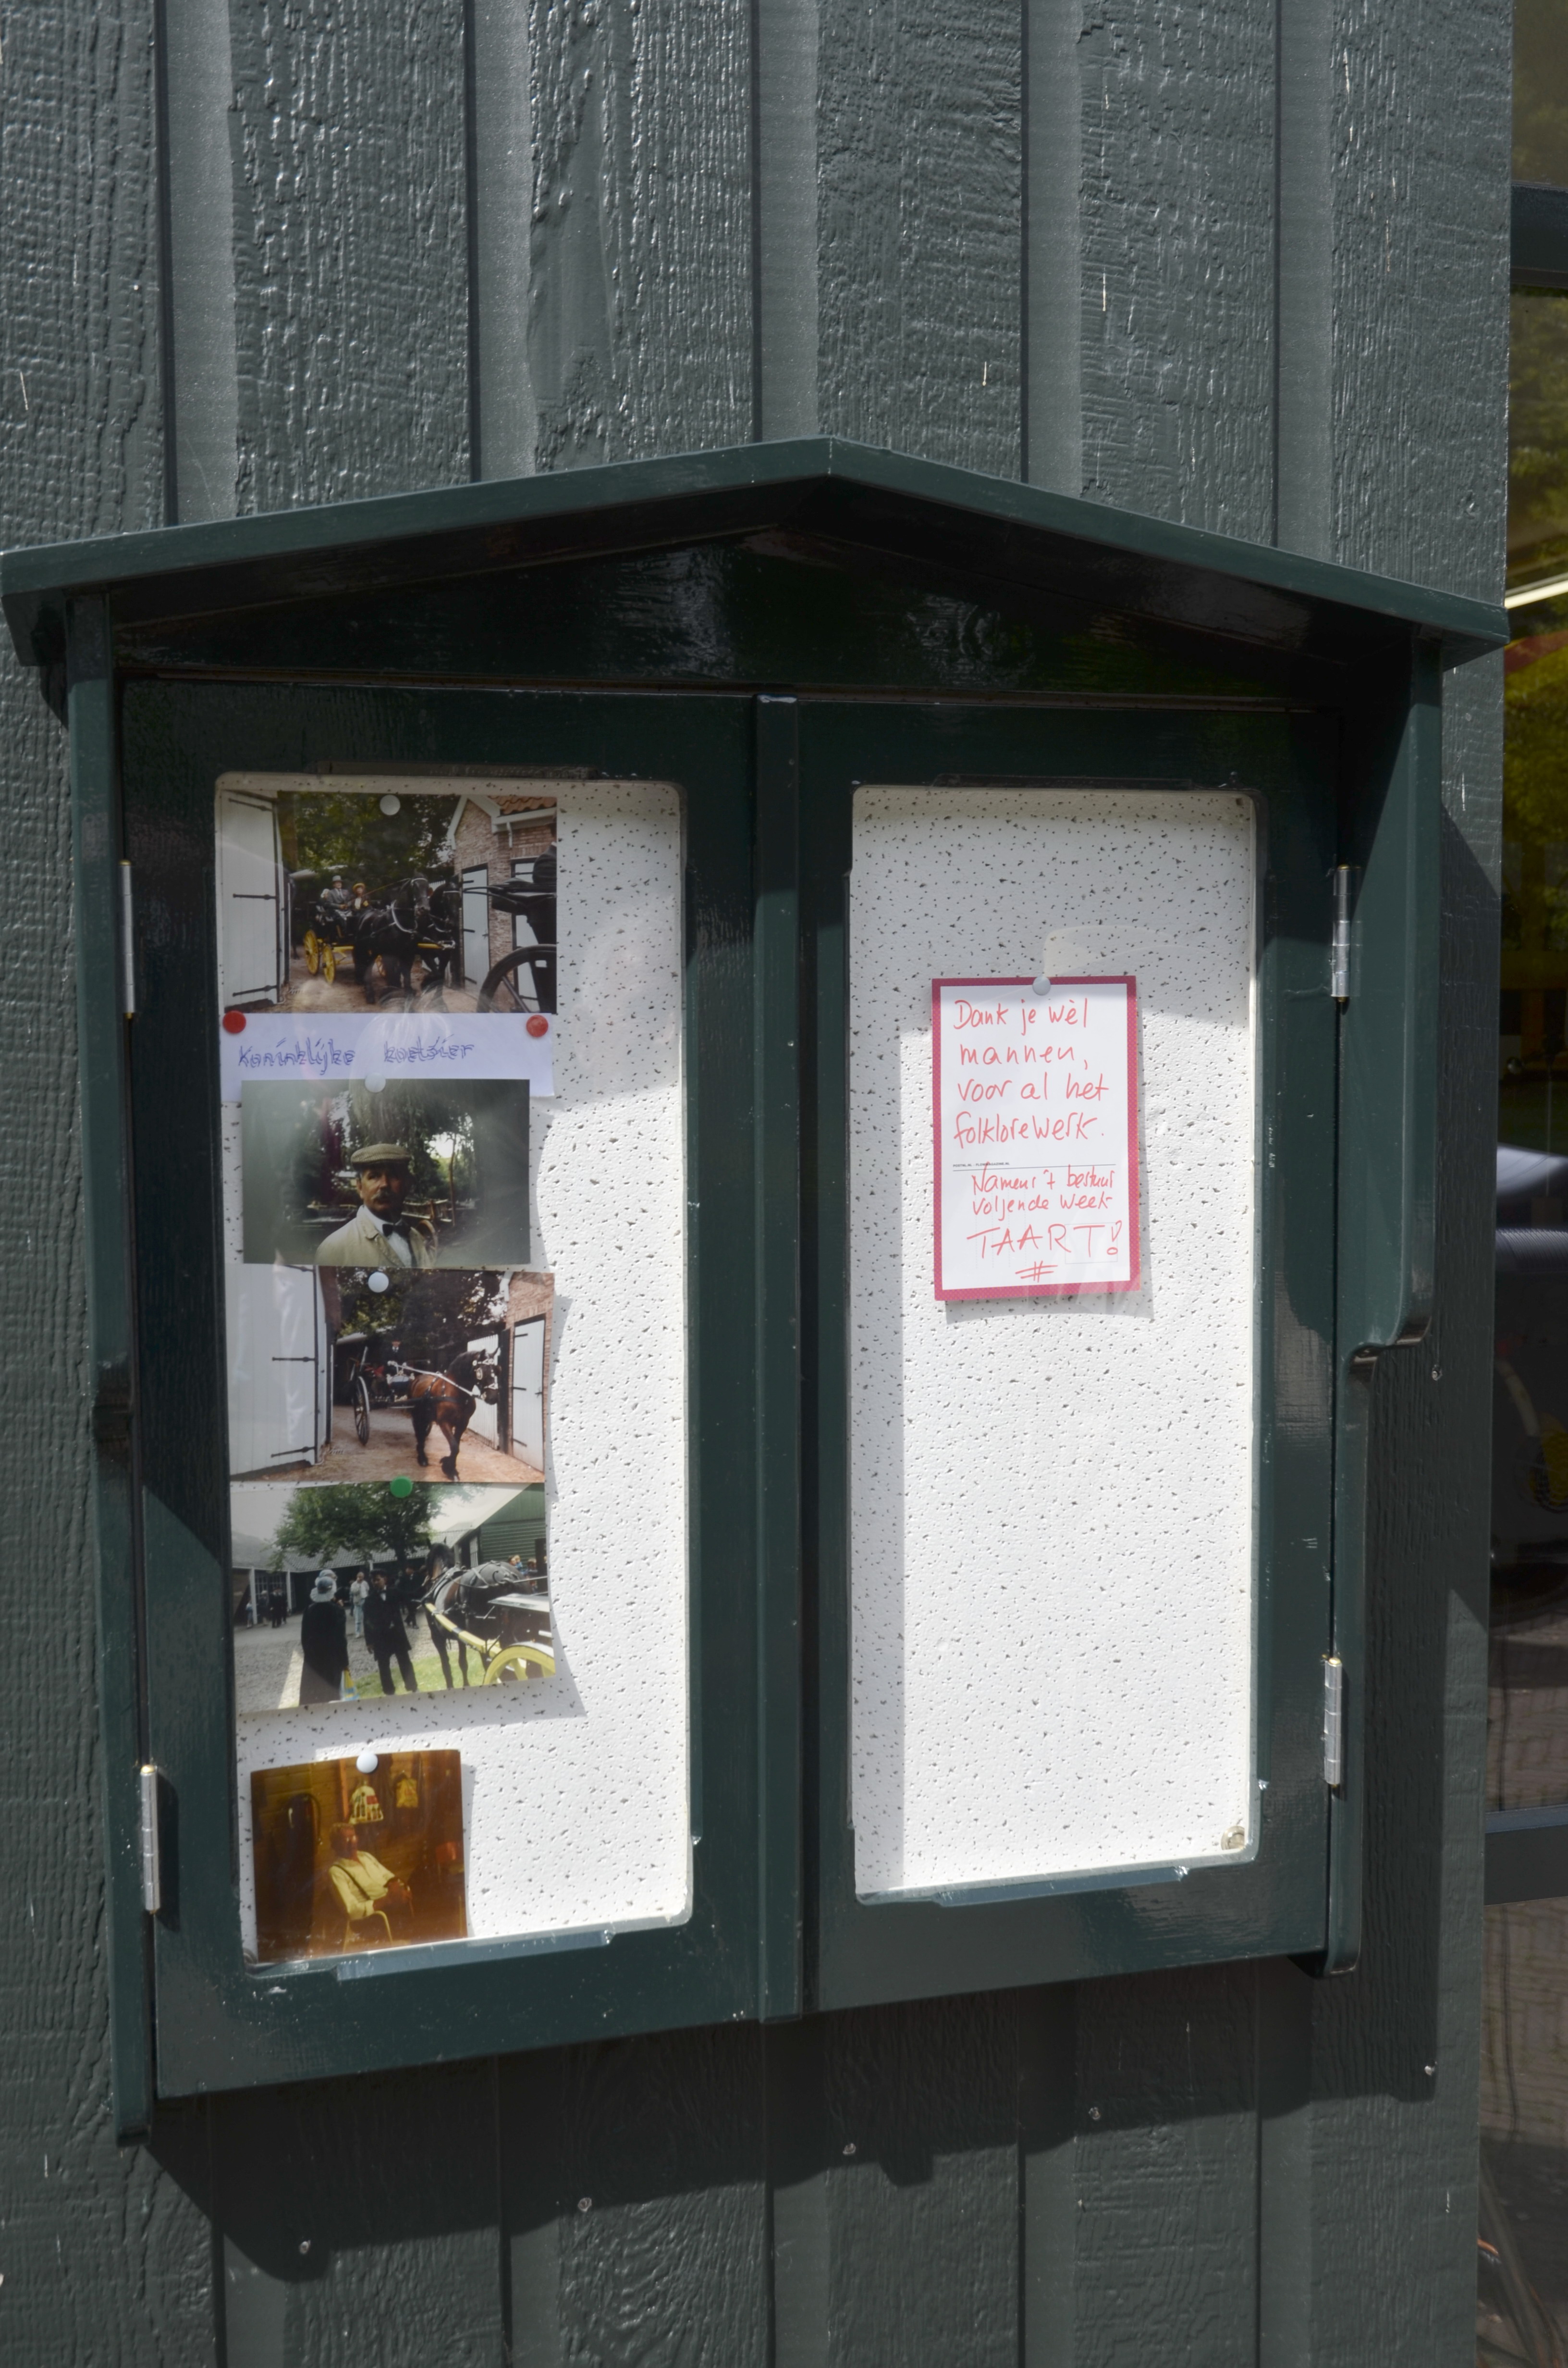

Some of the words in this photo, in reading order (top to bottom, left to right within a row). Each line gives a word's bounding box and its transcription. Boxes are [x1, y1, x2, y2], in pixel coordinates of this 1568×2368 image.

[953, 999, 1009, 1029] Dank
[1021, 998, 1037, 1036] je
[957, 1078, 1013, 1102] voor
[1020, 1071, 1048, 1100] al
[1066, 1072, 1110, 1101] het
